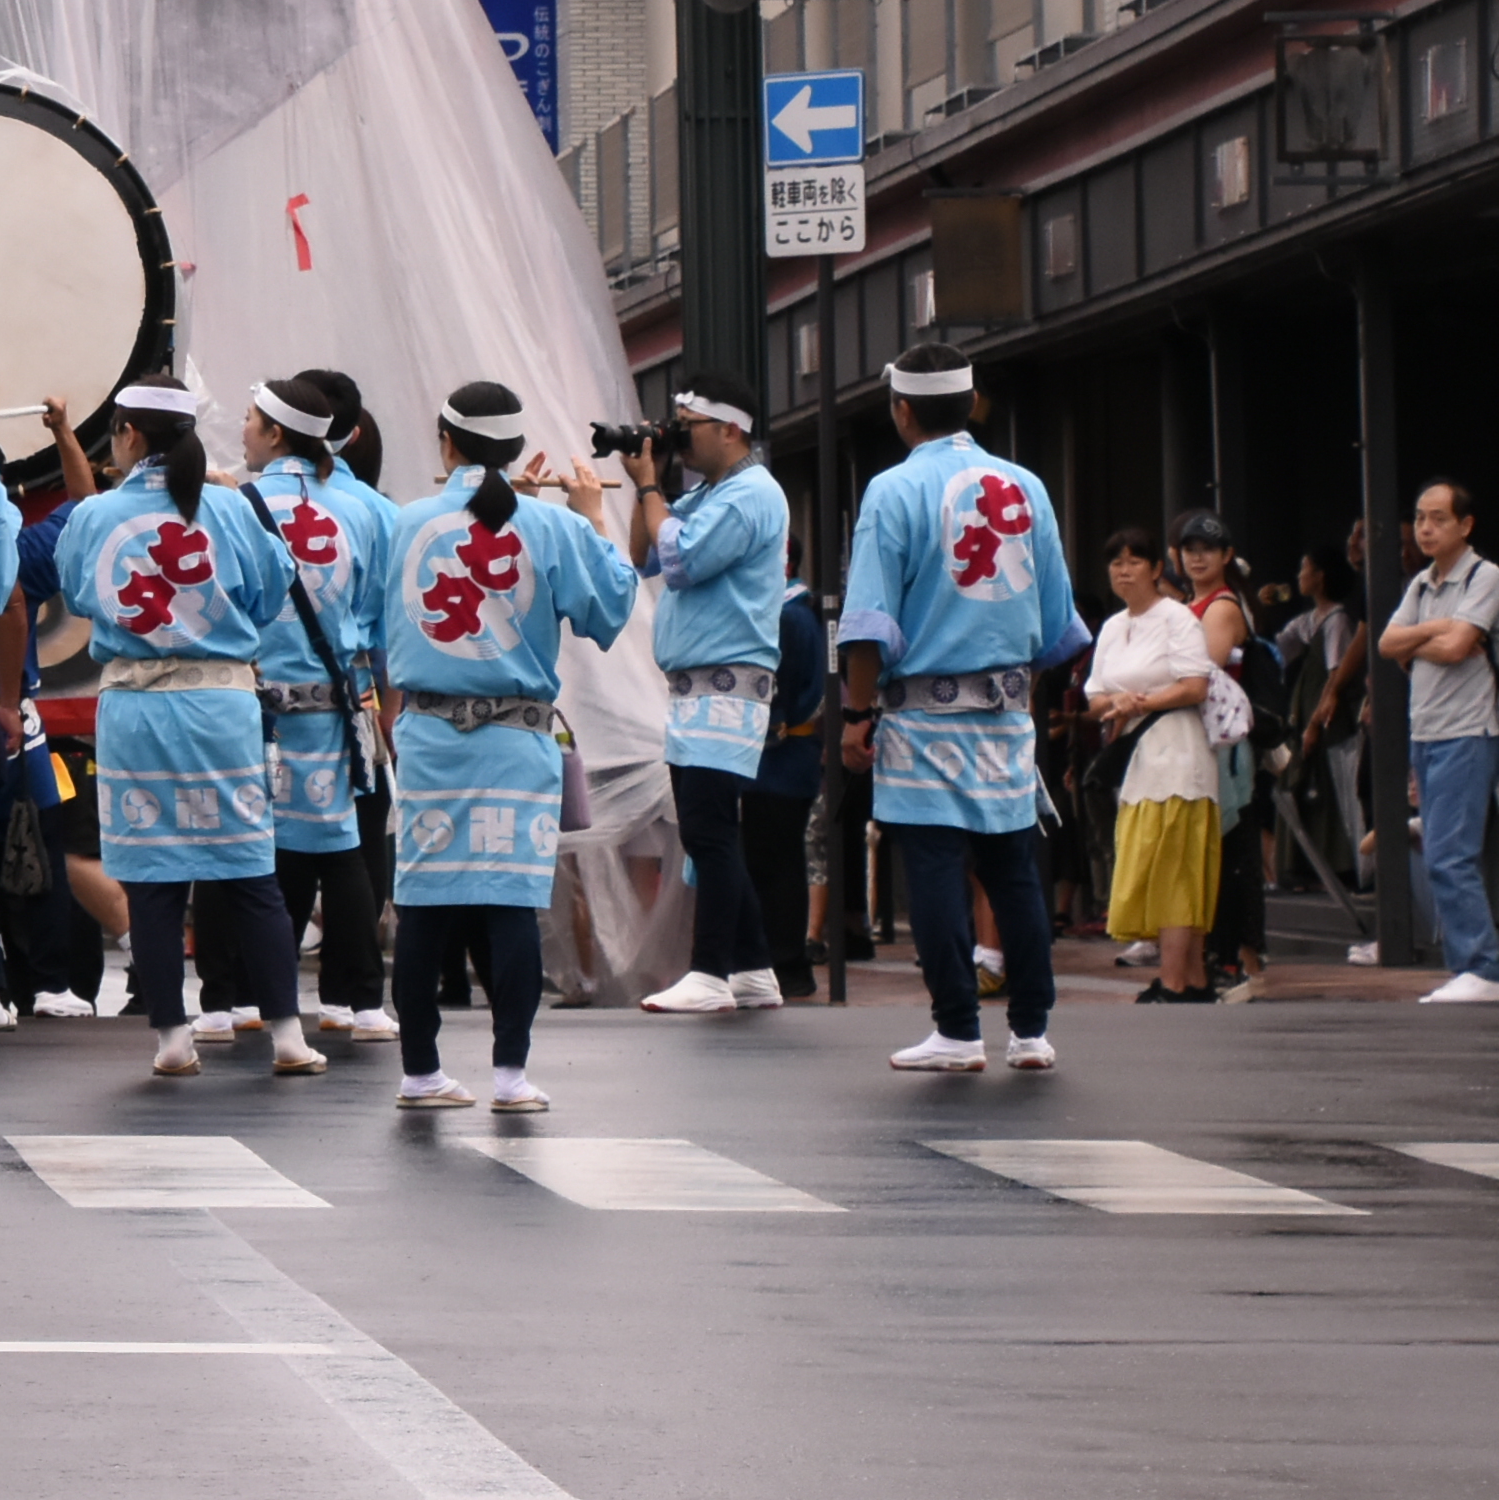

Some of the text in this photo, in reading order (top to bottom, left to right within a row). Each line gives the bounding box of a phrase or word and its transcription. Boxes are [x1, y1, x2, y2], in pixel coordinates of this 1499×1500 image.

[771, 177, 857, 207] 軽車両を除く
[775, 216, 855, 245] ここから
